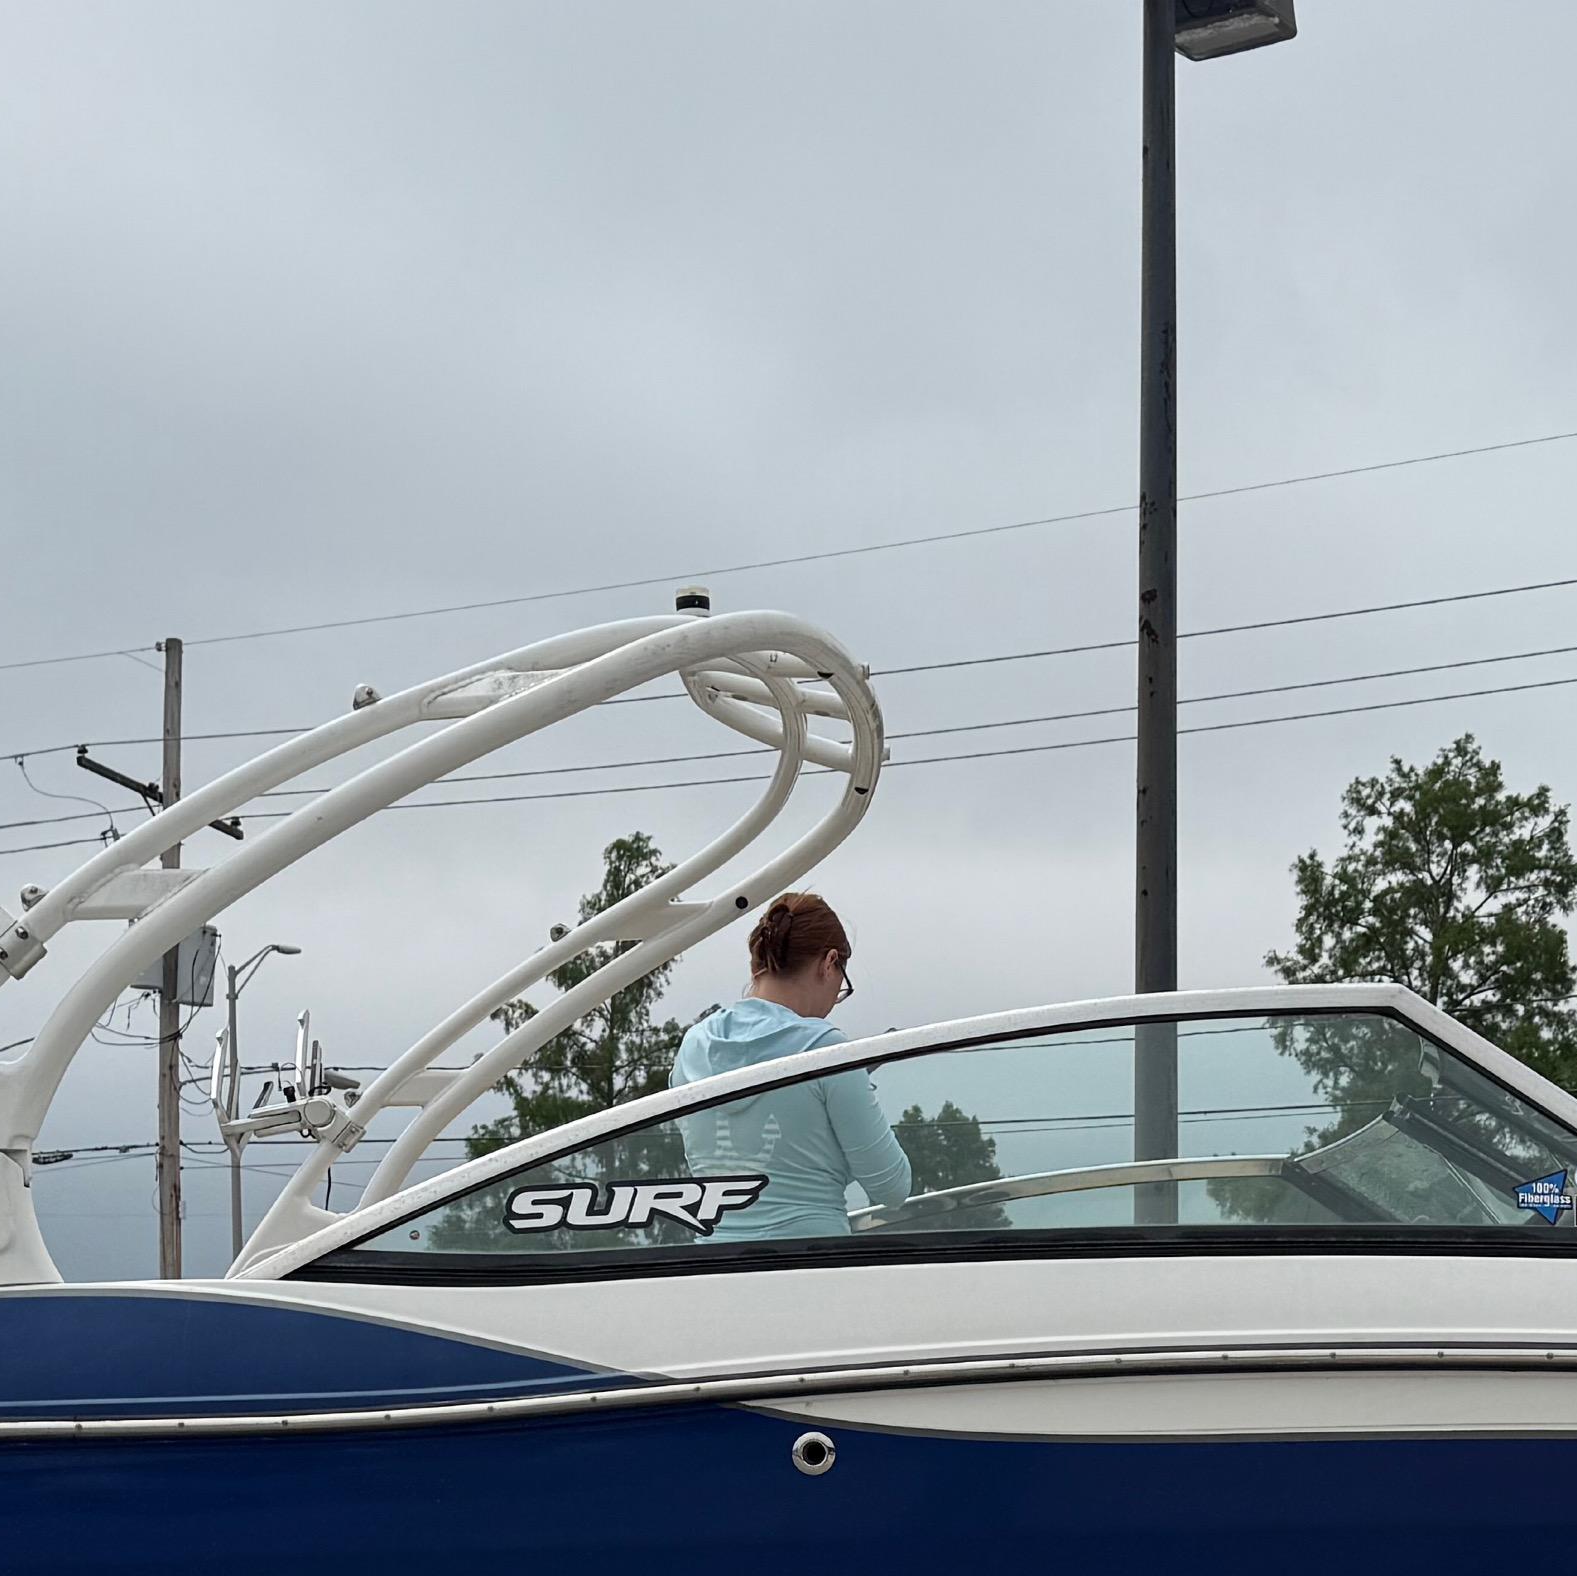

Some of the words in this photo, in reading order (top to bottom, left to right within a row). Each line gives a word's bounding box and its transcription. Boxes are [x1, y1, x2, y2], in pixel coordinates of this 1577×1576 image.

[1531, 1182, 1559, 1194] 100%
[506, 1178, 766, 1234] SURF
[1518, 1192, 1571, 1207] Fiberglass
